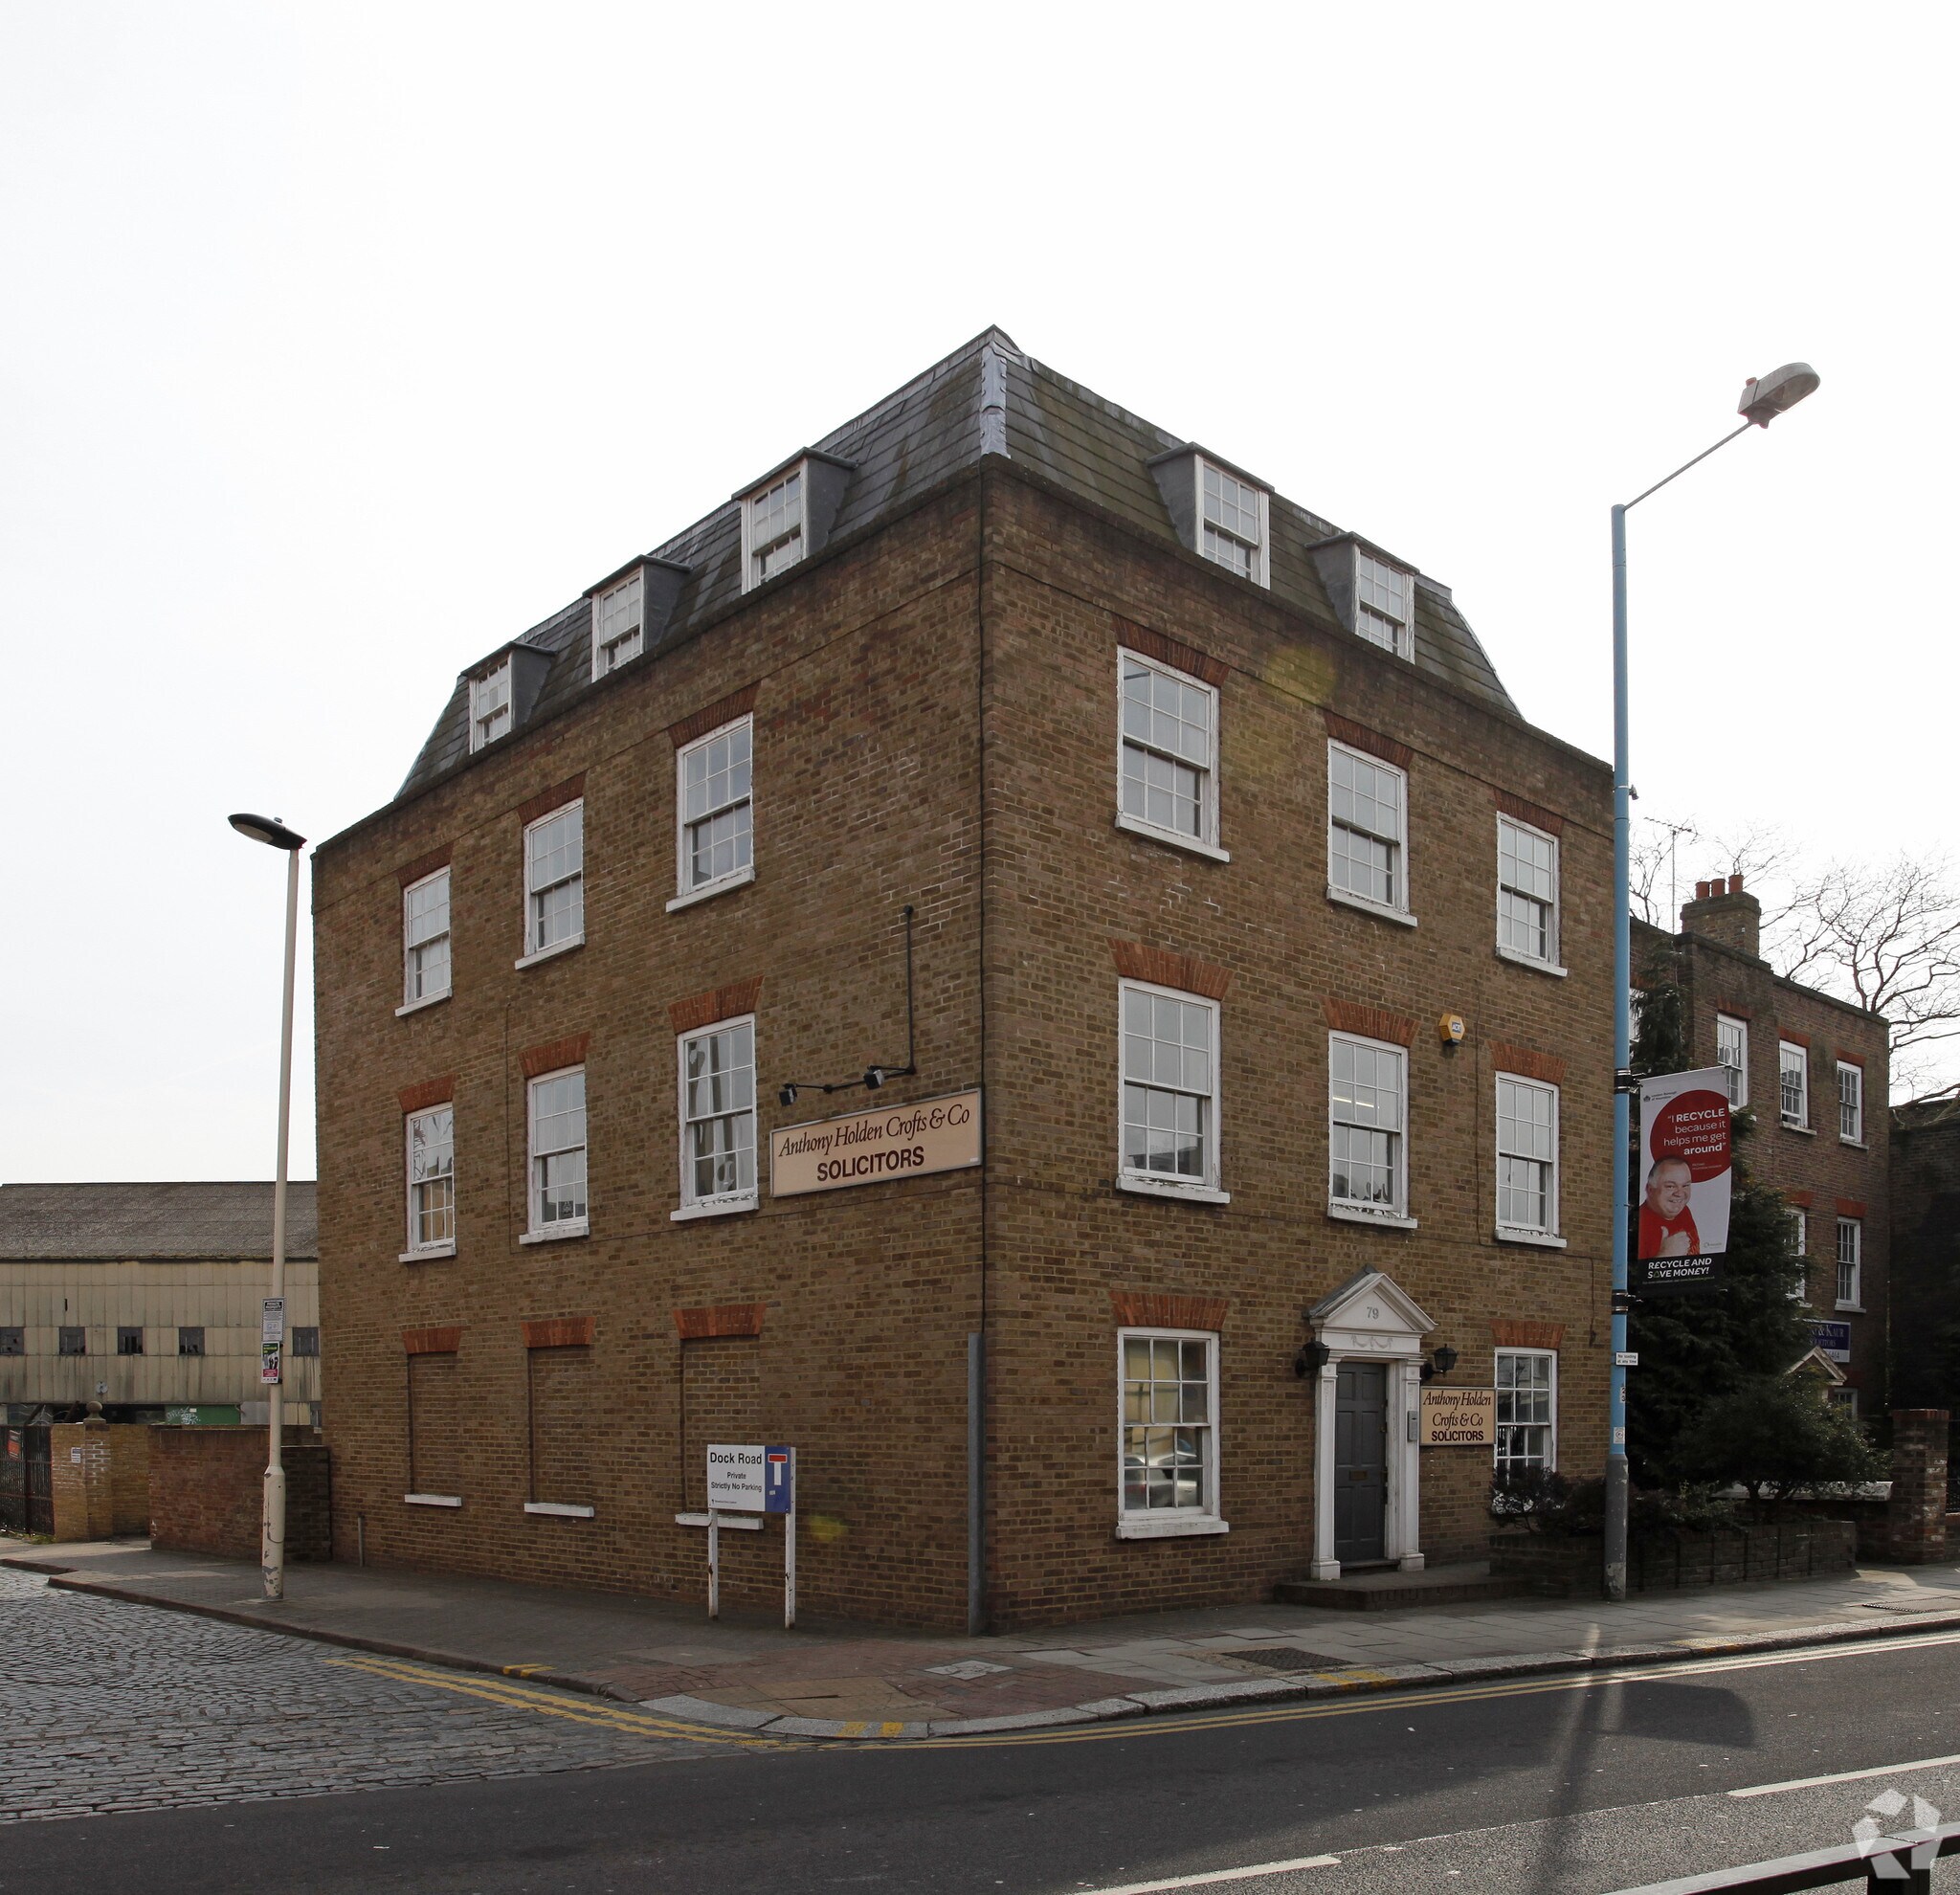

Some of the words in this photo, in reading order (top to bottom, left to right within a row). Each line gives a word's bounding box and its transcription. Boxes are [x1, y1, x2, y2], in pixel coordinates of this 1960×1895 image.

[1676, 1107, 1726, 1123] RECYCLE
[778, 1132, 833, 1156] Anthony
[835, 1120, 883, 1148] Holden
[886, 1110, 926, 1141] Crofts
[928, 1107, 946, 1129] &
[947, 1104, 970, 1126] Co
[1675, 1122, 1717, 1134] because
[1719, 1119, 1726, 1128] it
[1663, 1136, 1690, 1147] helps
[1691, 1133, 1708, 1143] me
[1709, 1131, 1726, 1144] get
[816, 1146, 925, 1182] SOLICITORS
[1691, 1258, 1712, 1266] AND
[1366, 1306, 1379, 1320] 79
[1423, 1391, 1460, 1411] Anthony
[1460, 1391, 1491, 1406] Holden
[1432, 1411, 1459, 1431] Crofts
[1459, 1413, 1469, 1426] &
[1470, 1413, 1483, 1426] Co
[1432, 1431, 1484, 1441] SOLICITORS
[710, 1452, 735, 1463] Dock
[738, 1453, 763, 1464] Road
[726, 1471, 746, 1480] Private
[710, 1482, 731, 1491] Strictly
[741, 1483, 763, 1493] Parking
